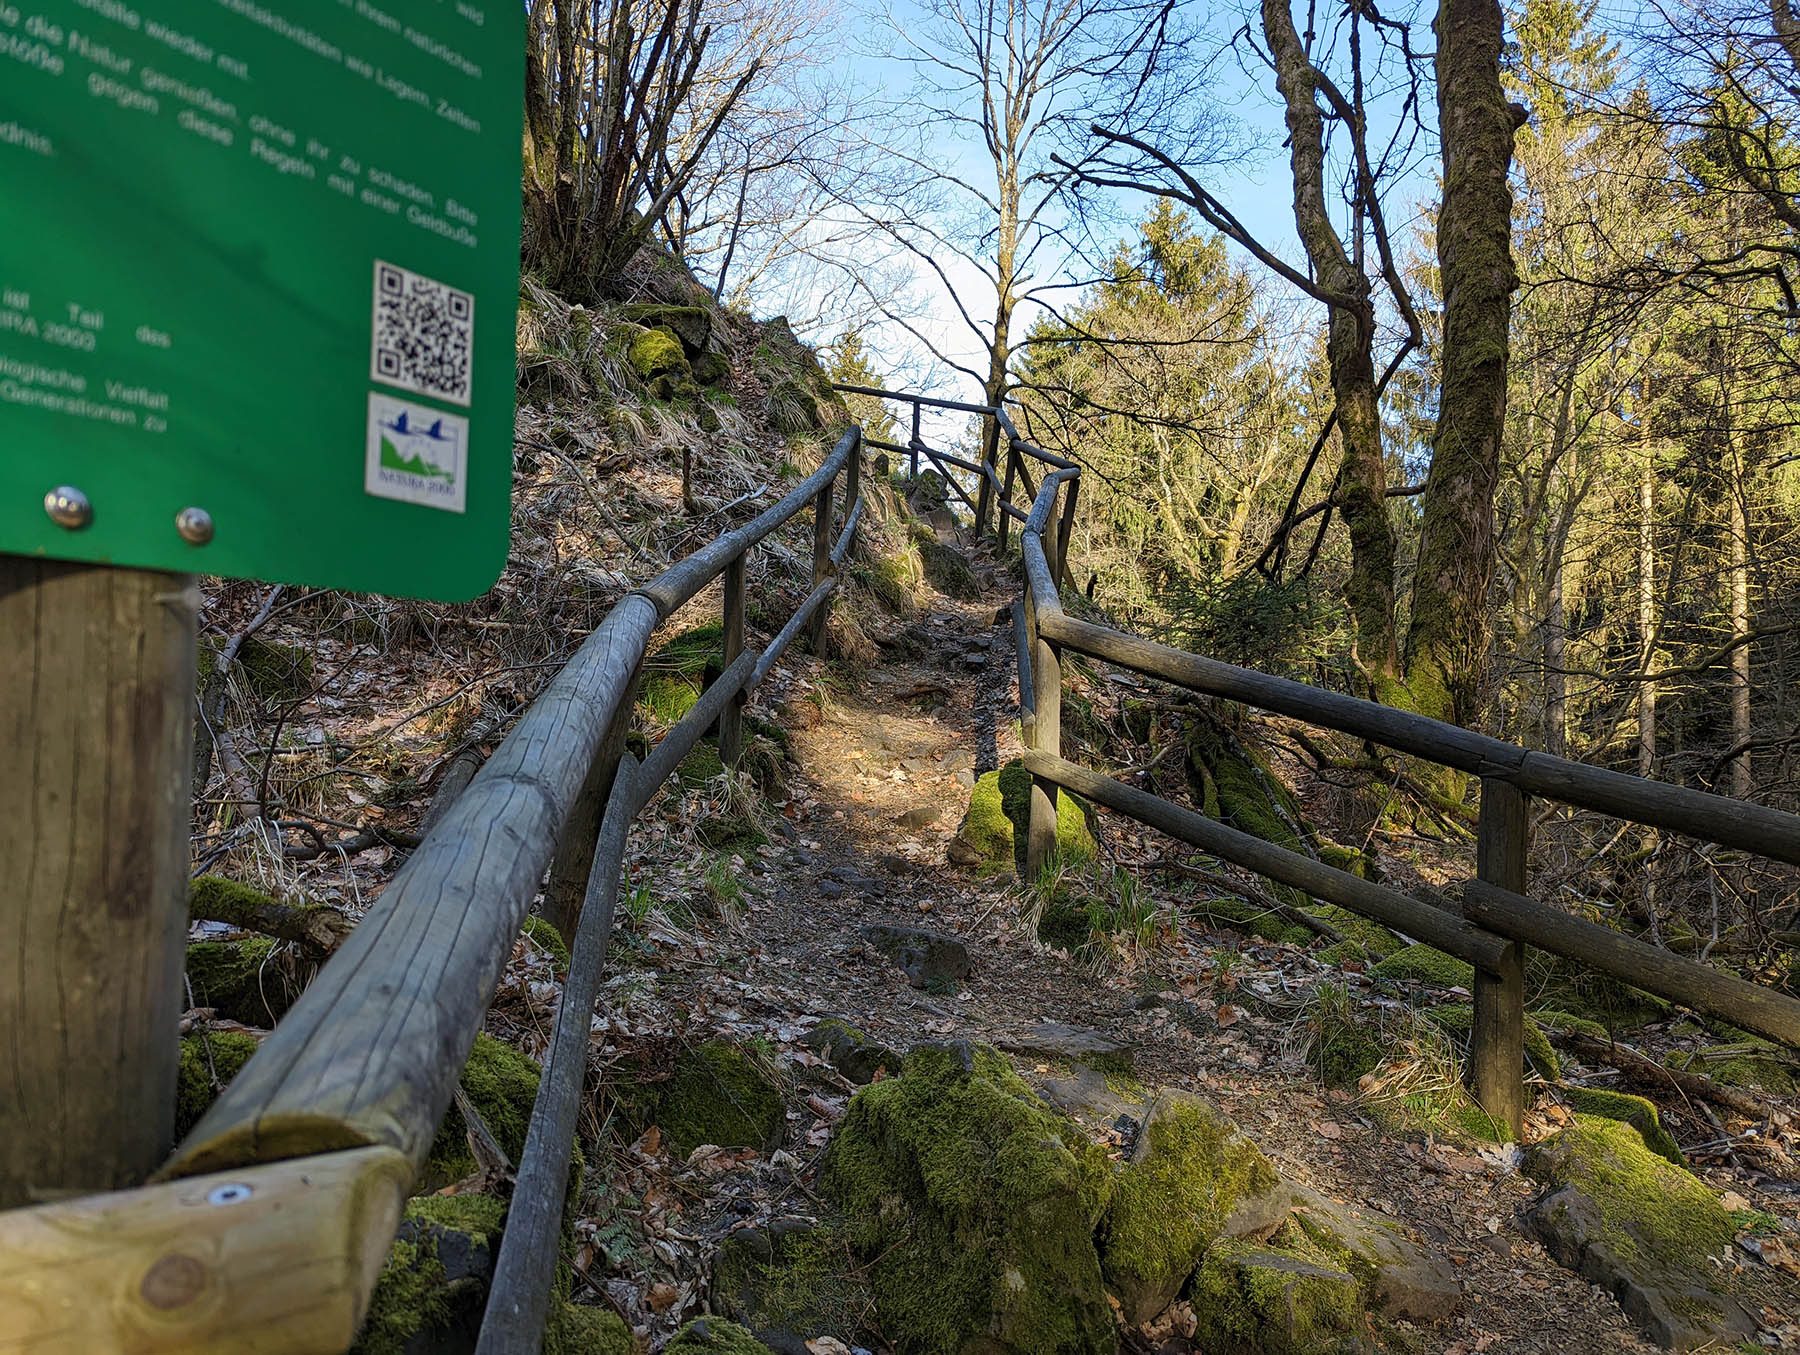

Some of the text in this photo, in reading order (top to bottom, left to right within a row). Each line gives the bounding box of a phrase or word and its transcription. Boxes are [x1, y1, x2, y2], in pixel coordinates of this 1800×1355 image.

[145, 19, 213, 62] wieder
[217, 54, 252, 80] mit.
[404, 26, 481, 77] natürlichen
[25, 15, 63, 45] die
[69, 30, 131, 73] Natur
[141, 67, 240, 123] genießen,
[249, 115, 295, 146] ohne
[339, 154, 360, 175] zu
[446, 198, 477, 226] Bitte
[345, 55, 373, 78] wie
[377, 68, 431, 109] Lagern,
[436, 99, 480, 133] Zelten
[88, 72, 158, 115] gegen
[178, 109, 233, 147] diese
[251, 138, 314, 180] Regeln
[328, 173, 355, 197] mit
[360, 187, 401, 215] einer
[407, 205, 479, 248] Geldbuße
[3, 288, 173, 348] ist Teil des
[43, 321, 96, 351] 2000
[0, 356, 168, 410] logische Vielfalt
[0, 380, 168, 432] Generationen zu
[379, 470, 456, 497] NATURA 2000
